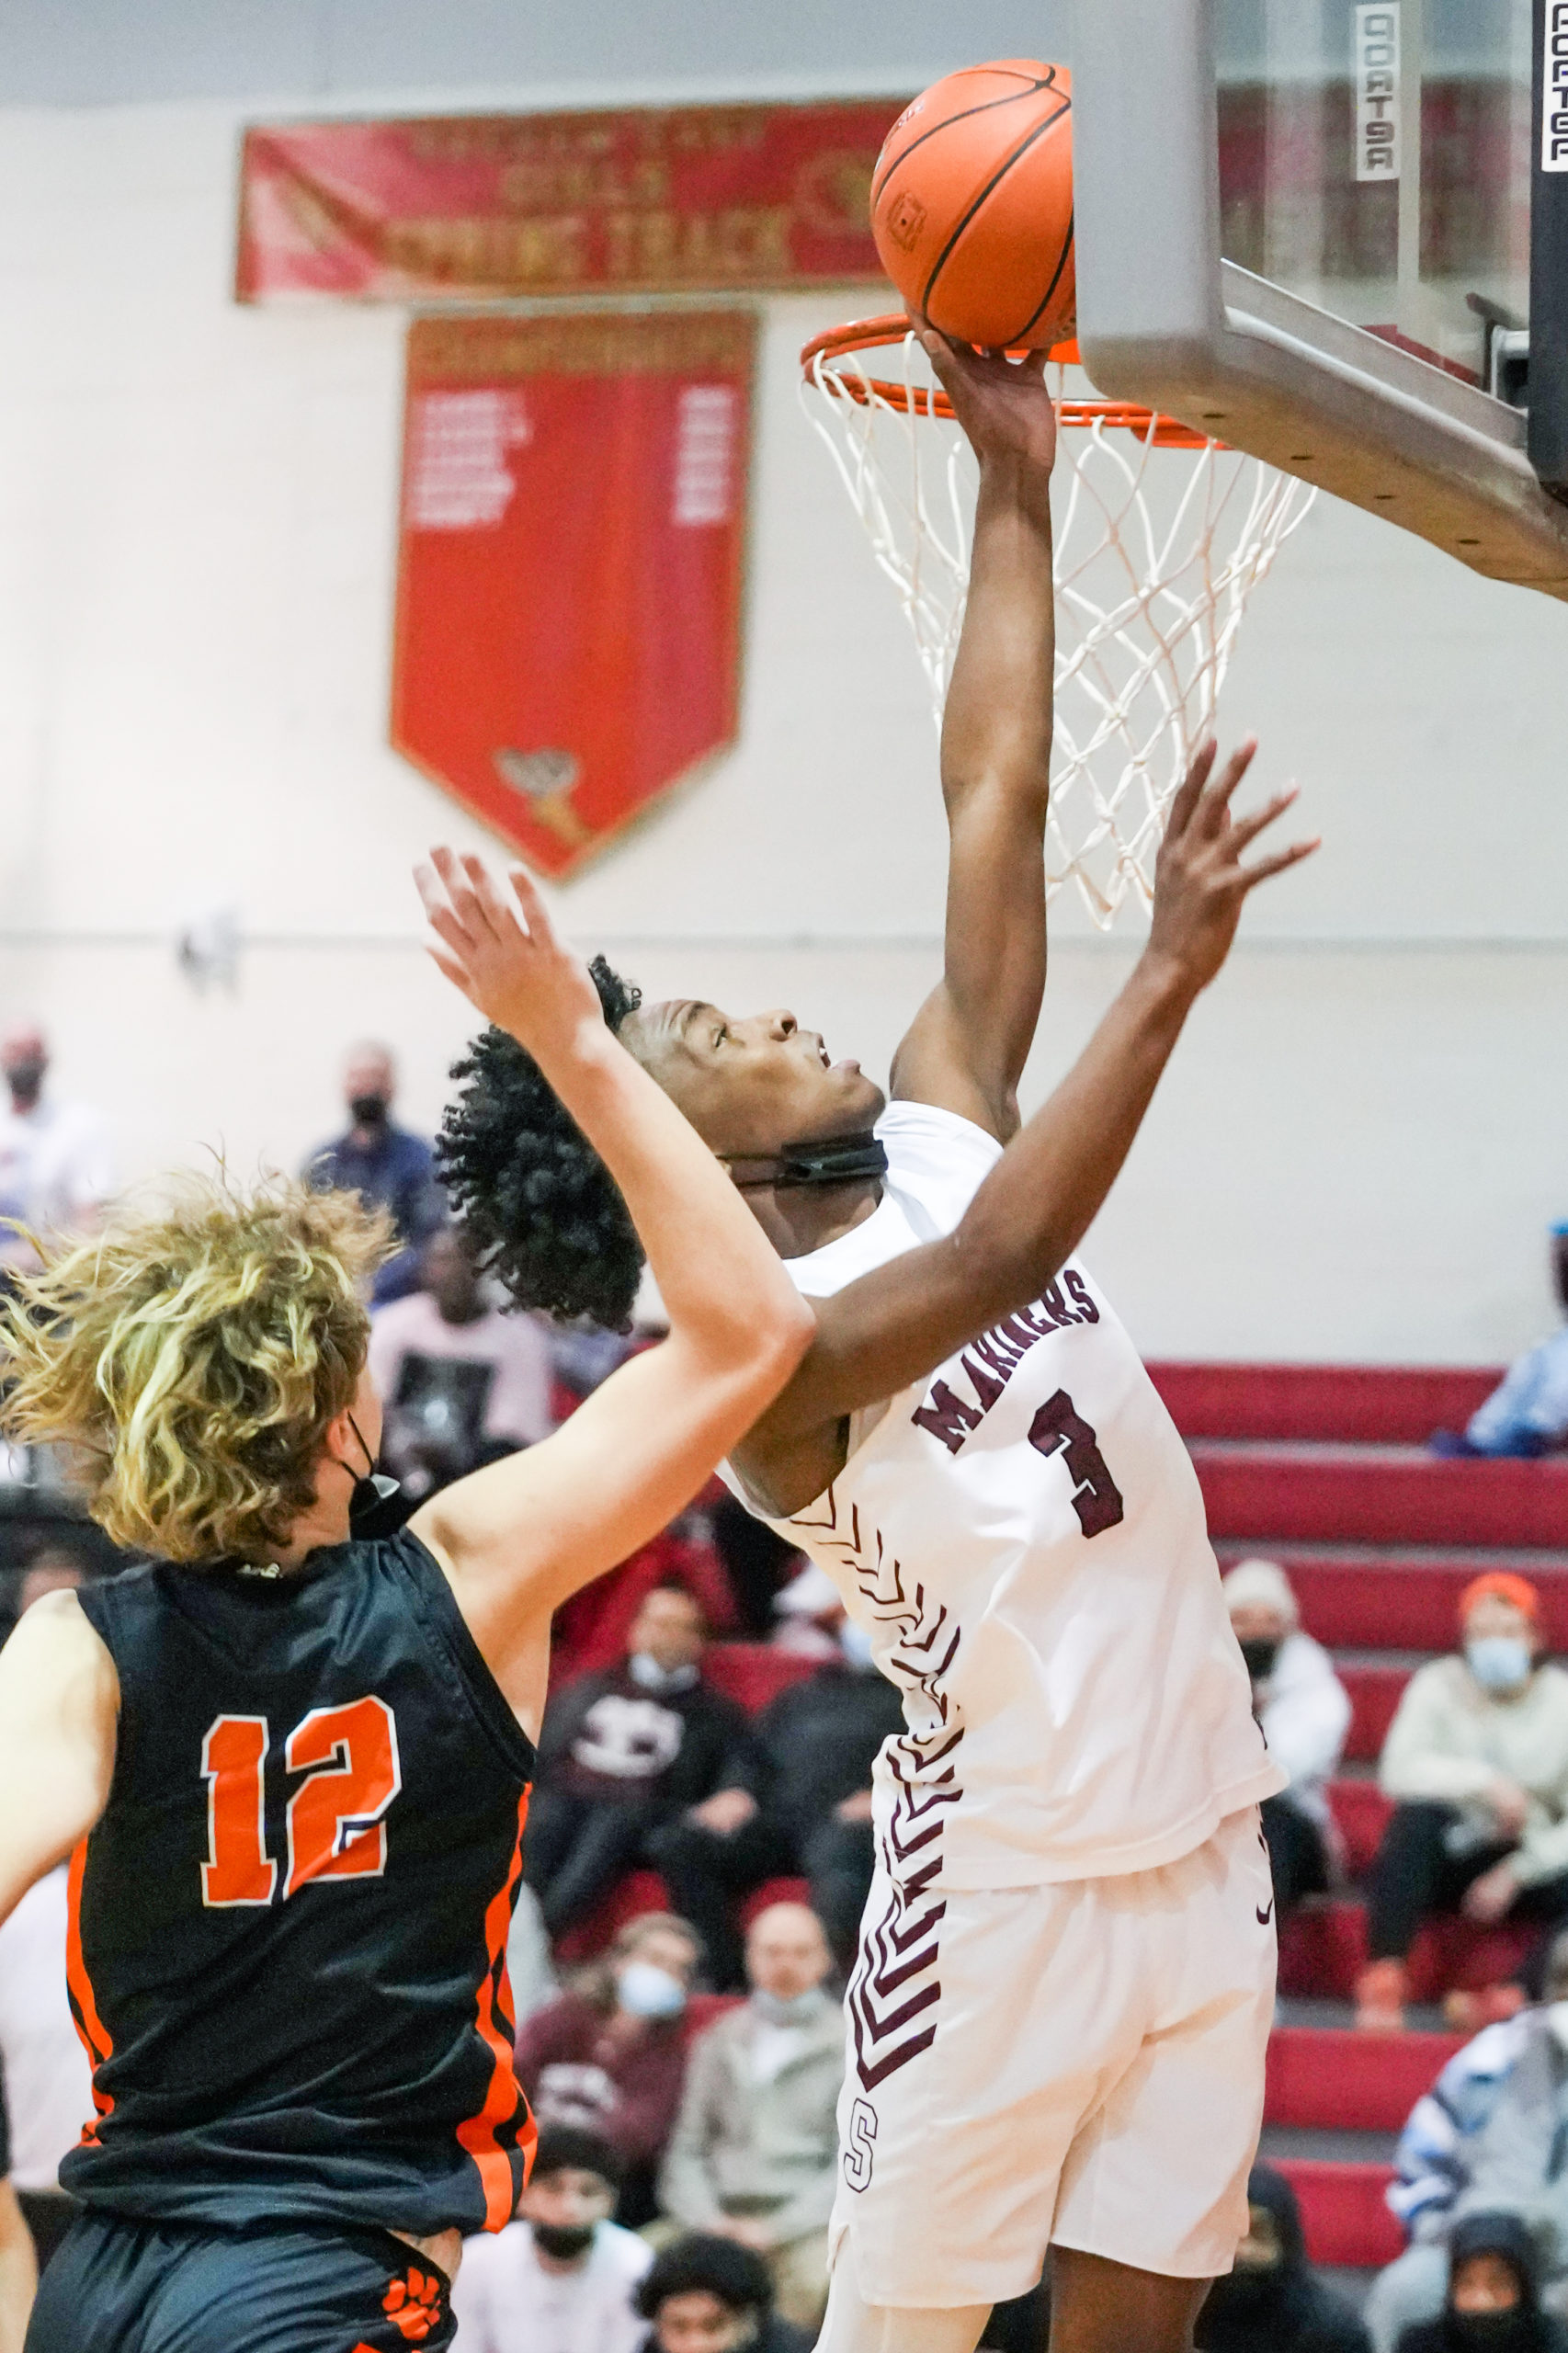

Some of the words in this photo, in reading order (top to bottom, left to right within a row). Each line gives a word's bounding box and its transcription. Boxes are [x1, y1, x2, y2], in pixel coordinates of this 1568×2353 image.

[1027, 1387, 1124, 1540] 3
[199, 1694, 403, 1907] 12
[843, 2097, 879, 2194] S
